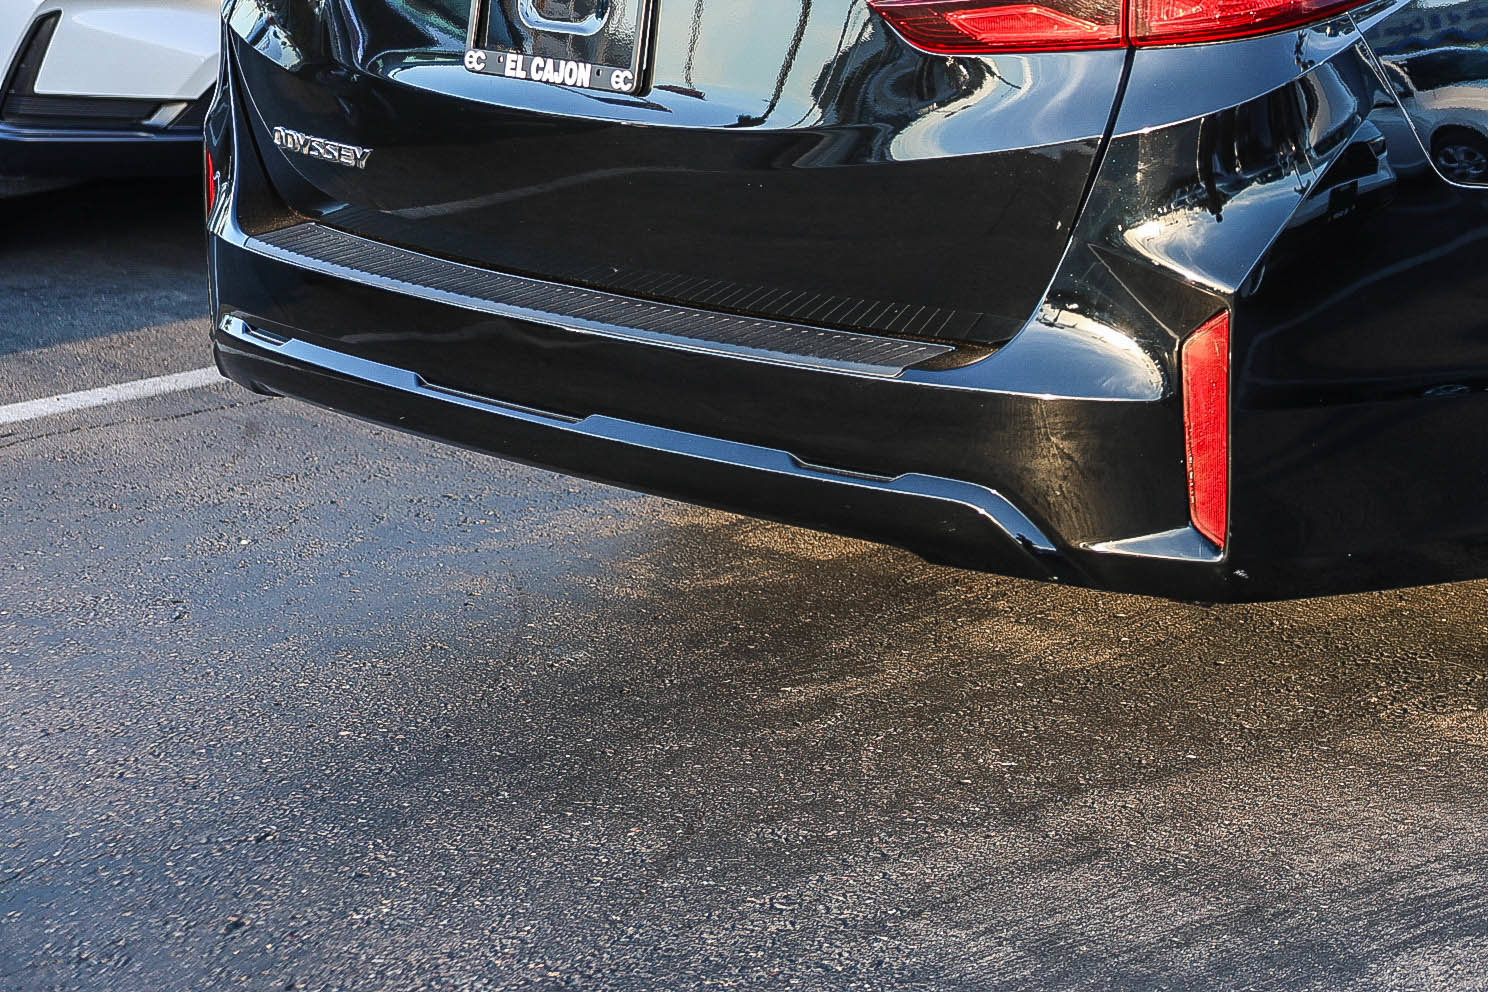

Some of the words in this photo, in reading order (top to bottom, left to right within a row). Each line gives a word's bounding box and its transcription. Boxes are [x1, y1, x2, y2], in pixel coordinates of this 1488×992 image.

[504, 52, 526, 79] EL
[530, 59, 592, 88] CAJON
[273, 126, 374, 169] ODYSSEY
